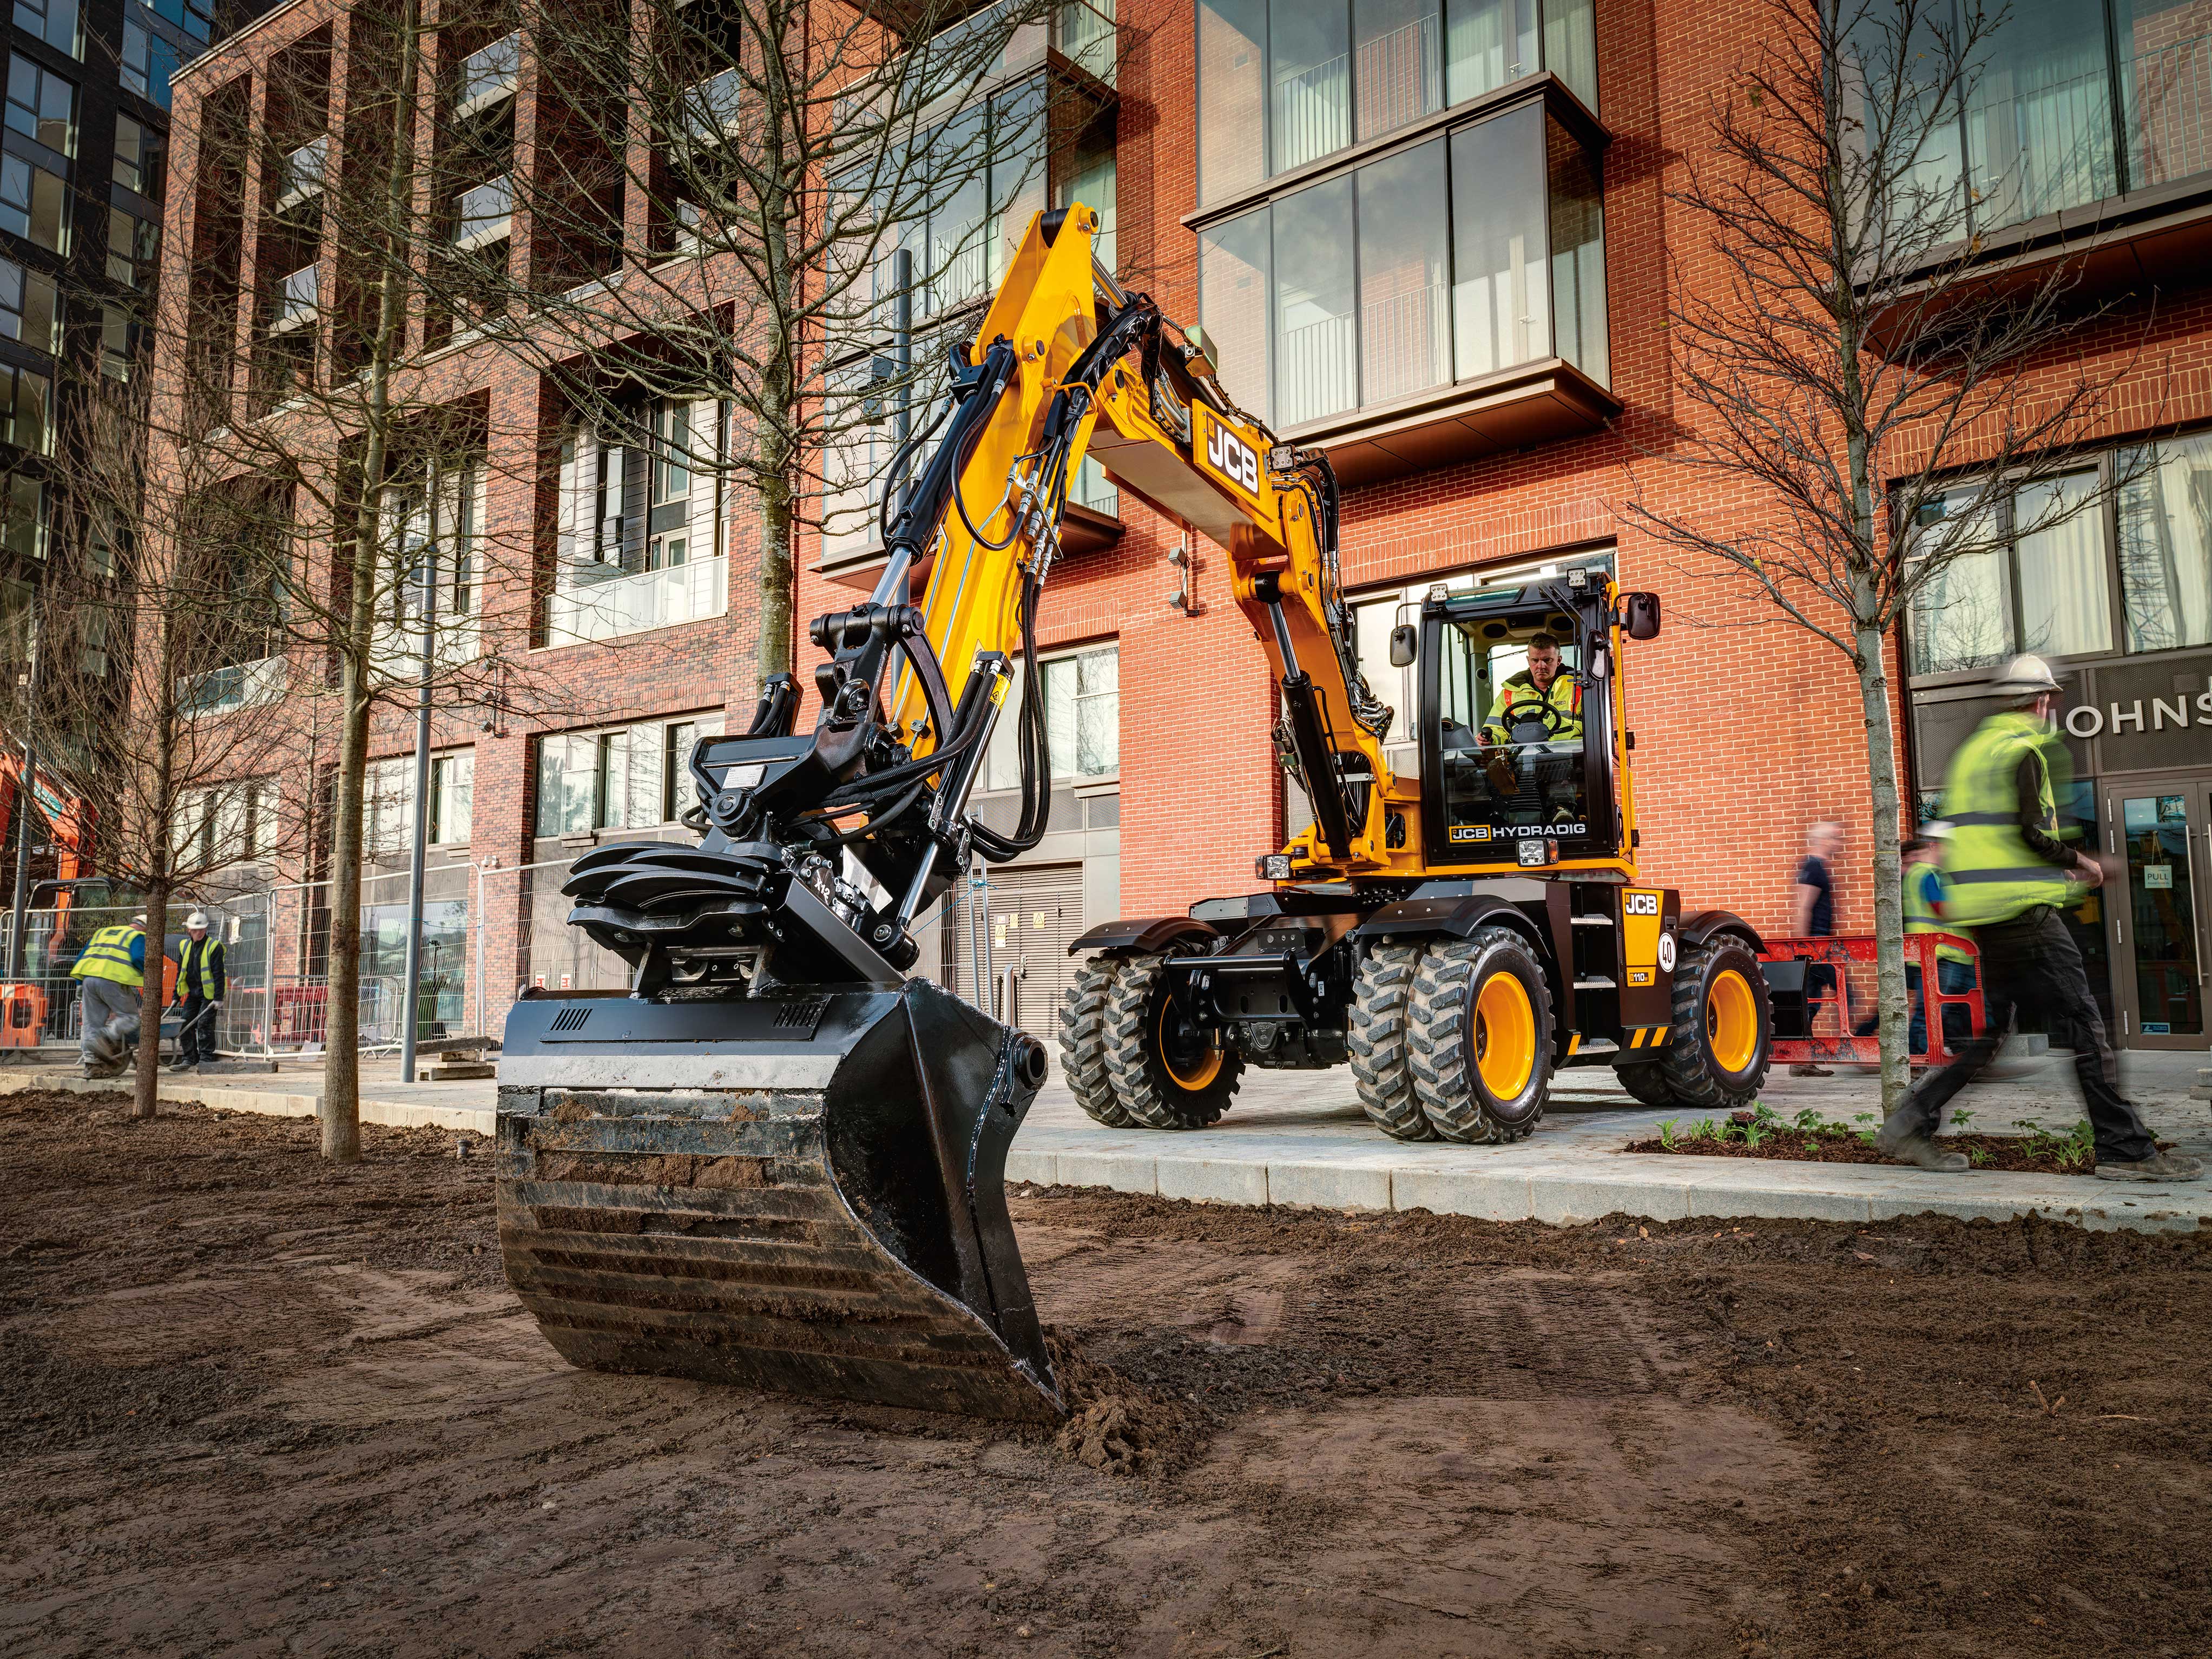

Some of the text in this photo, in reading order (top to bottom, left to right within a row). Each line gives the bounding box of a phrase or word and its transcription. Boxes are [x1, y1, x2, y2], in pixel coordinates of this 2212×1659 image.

[1208, 424, 1259, 493] JCB
[1517, 725, 1541, 733] JCB
[1452, 824, 1586, 839] JCB HYDRADIG
[1625, 894, 1657, 914] JCB
[1662, 941, 1672, 964] 40
